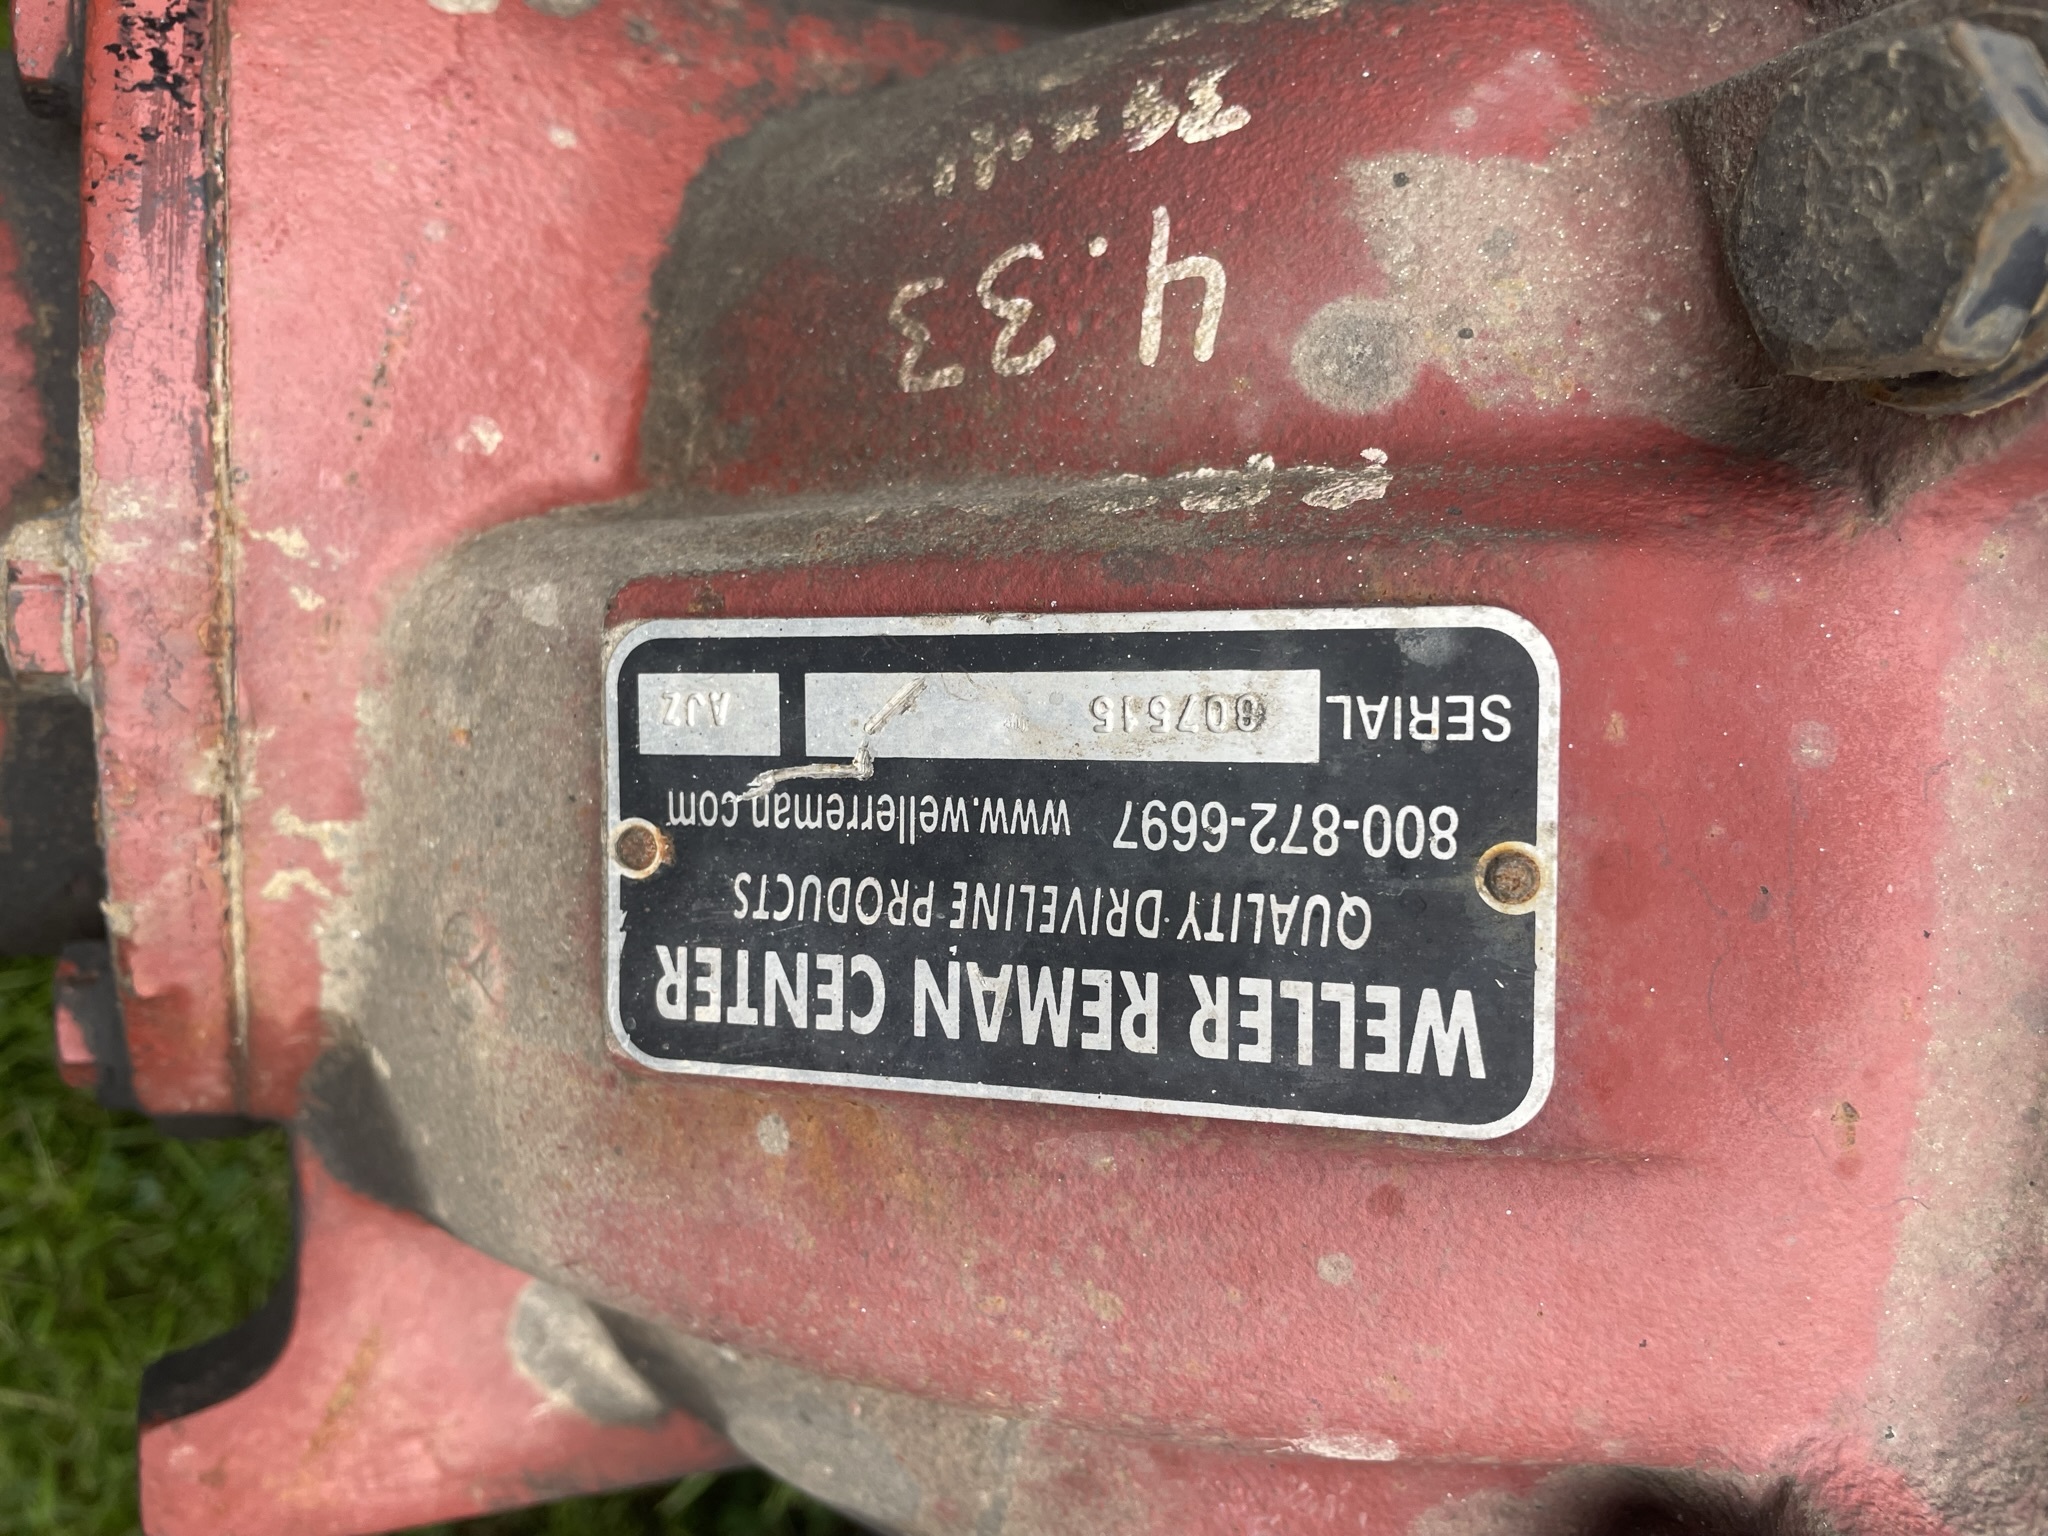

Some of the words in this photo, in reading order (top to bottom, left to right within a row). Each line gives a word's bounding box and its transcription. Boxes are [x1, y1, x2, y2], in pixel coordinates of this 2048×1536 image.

[888, 205, 1227, 392] 4.33
[662, 691, 731, 726] AJZ
[1325, 694, 1511, 742] SERIAL
[666, 790, 1071, 844] www.wellerremancom
[1113, 800, 1458, 860] 800-872-6697
[734, 872, 934, 928] PRODUCTS
[950, 881, 1163, 939] DRIVELINE
[1177, 890, 1371, 950] QUALITY
[655, 944, 886, 1035] CENTER
[913, 958, 1159, 1055] REMAN
[1188, 973, 1486, 1079] WELLER
